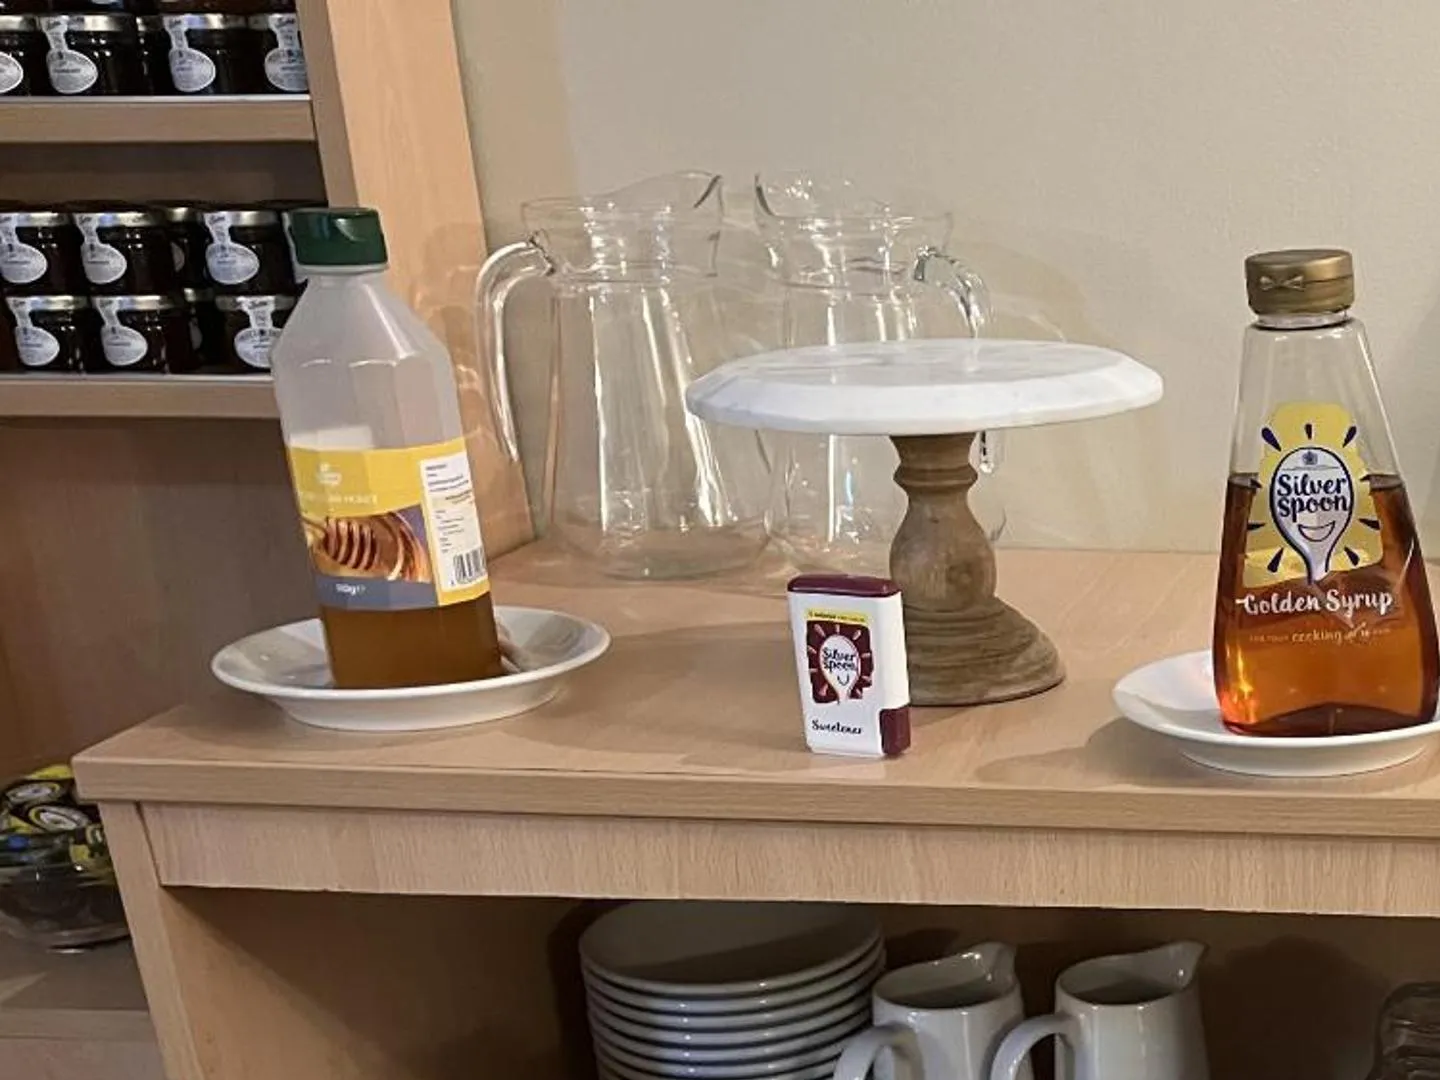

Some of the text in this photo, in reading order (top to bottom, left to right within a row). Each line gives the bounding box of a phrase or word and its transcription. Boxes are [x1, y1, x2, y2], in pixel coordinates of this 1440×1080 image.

[1277, 473, 1347, 497] Silver
[1236, 589, 1393, 622] Golden Syrup
[823, 648, 855, 661] Silver
[812, 719, 862, 734] Sweetener
